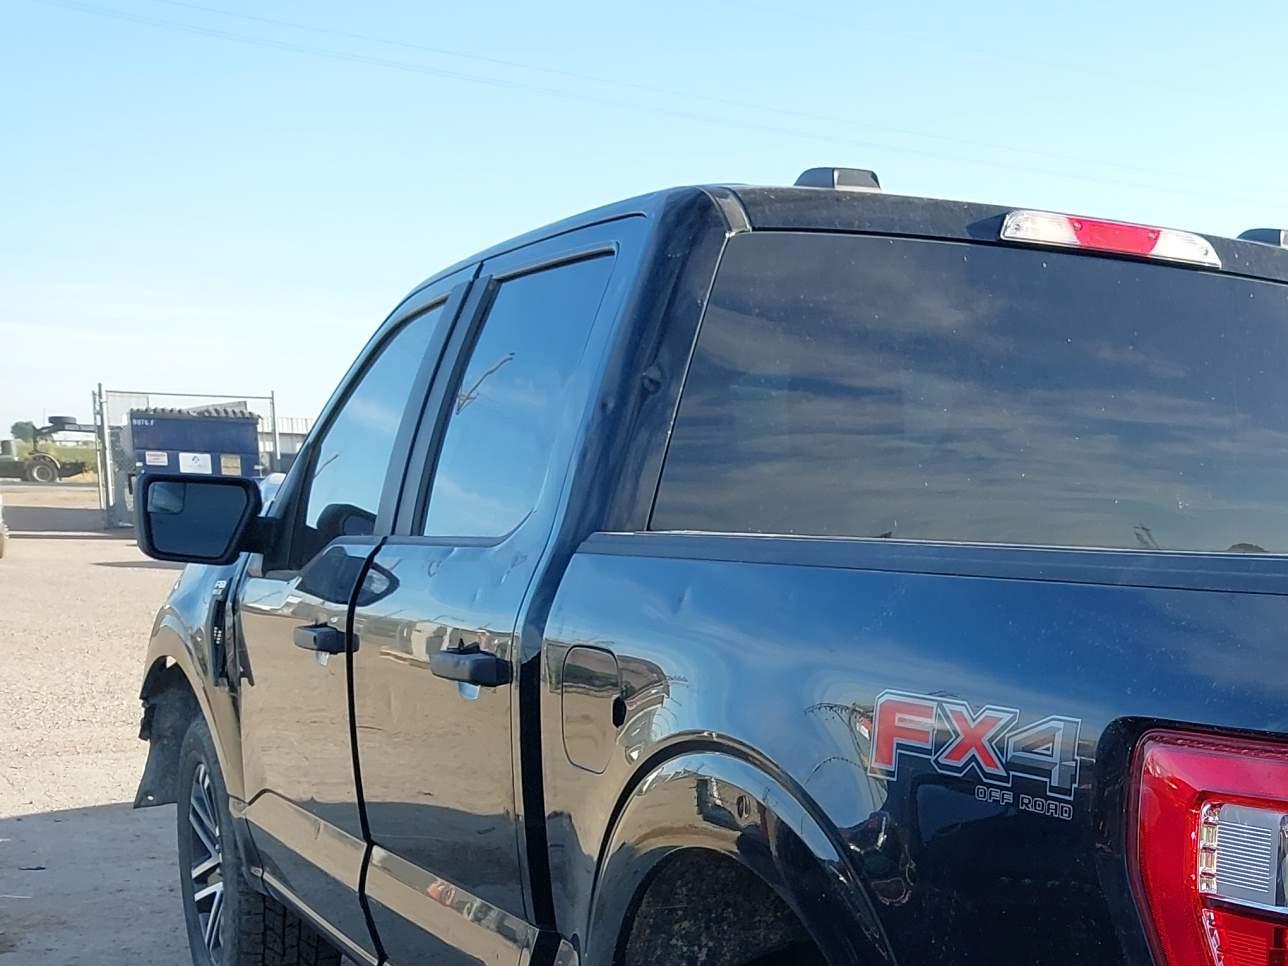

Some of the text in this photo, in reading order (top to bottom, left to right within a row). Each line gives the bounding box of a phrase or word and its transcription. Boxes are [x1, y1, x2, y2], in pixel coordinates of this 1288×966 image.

[867, 688, 1082, 800] FX4
[975, 785, 1073, 820] OFF ROAD
